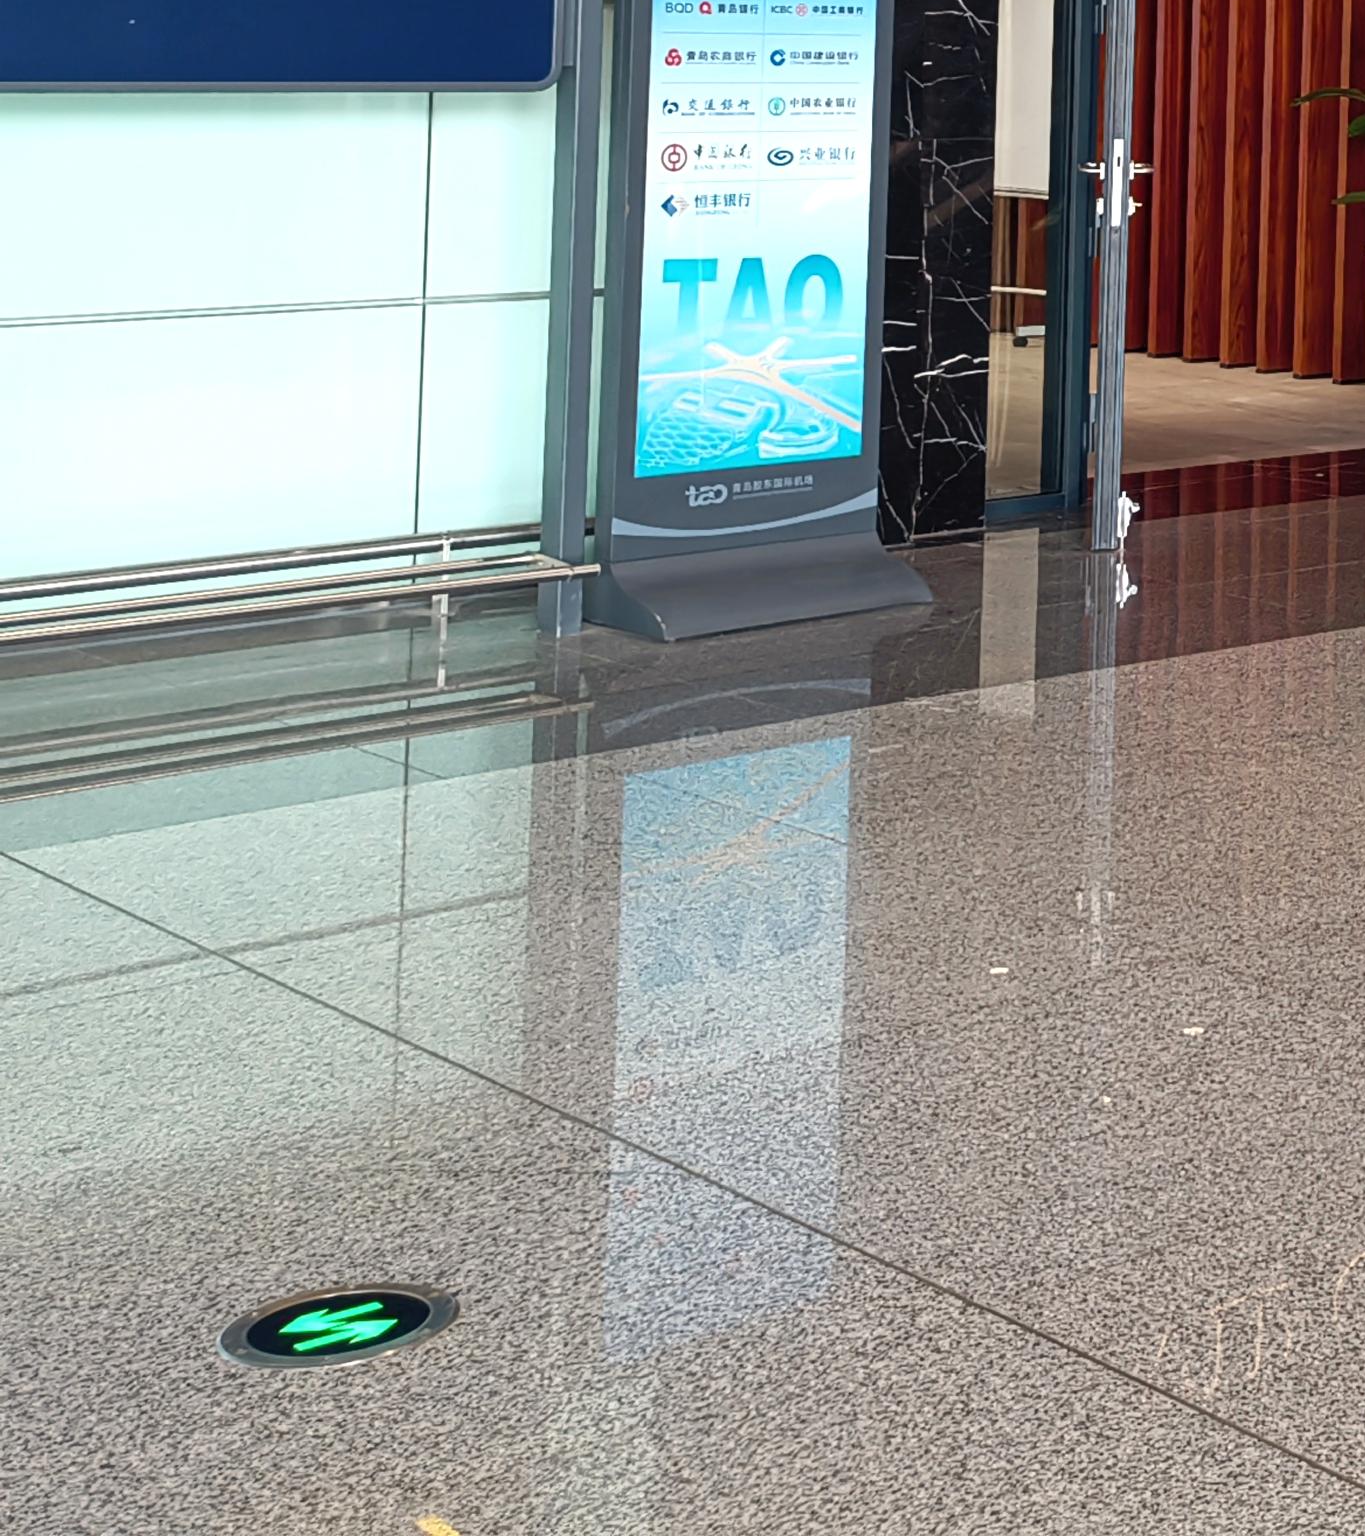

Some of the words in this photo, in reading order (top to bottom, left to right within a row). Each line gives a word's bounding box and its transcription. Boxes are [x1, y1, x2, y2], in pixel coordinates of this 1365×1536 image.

[665, 2, 694, 13] BQD
[718, 3, 759, 14] 青岛银行
[771, 5, 793, 14] ICBC
[686, 50, 757, 61] 青岛农商银行
[790, 50, 858, 60] 中国建设银行
[689, 99, 750, 110] 交通银行
[790, 97, 856, 108] 中国农业银行
[695, 193, 751, 208] 恒丰银行
[662, 254, 843, 334] TAO
[685, 484, 728, 507] tao
